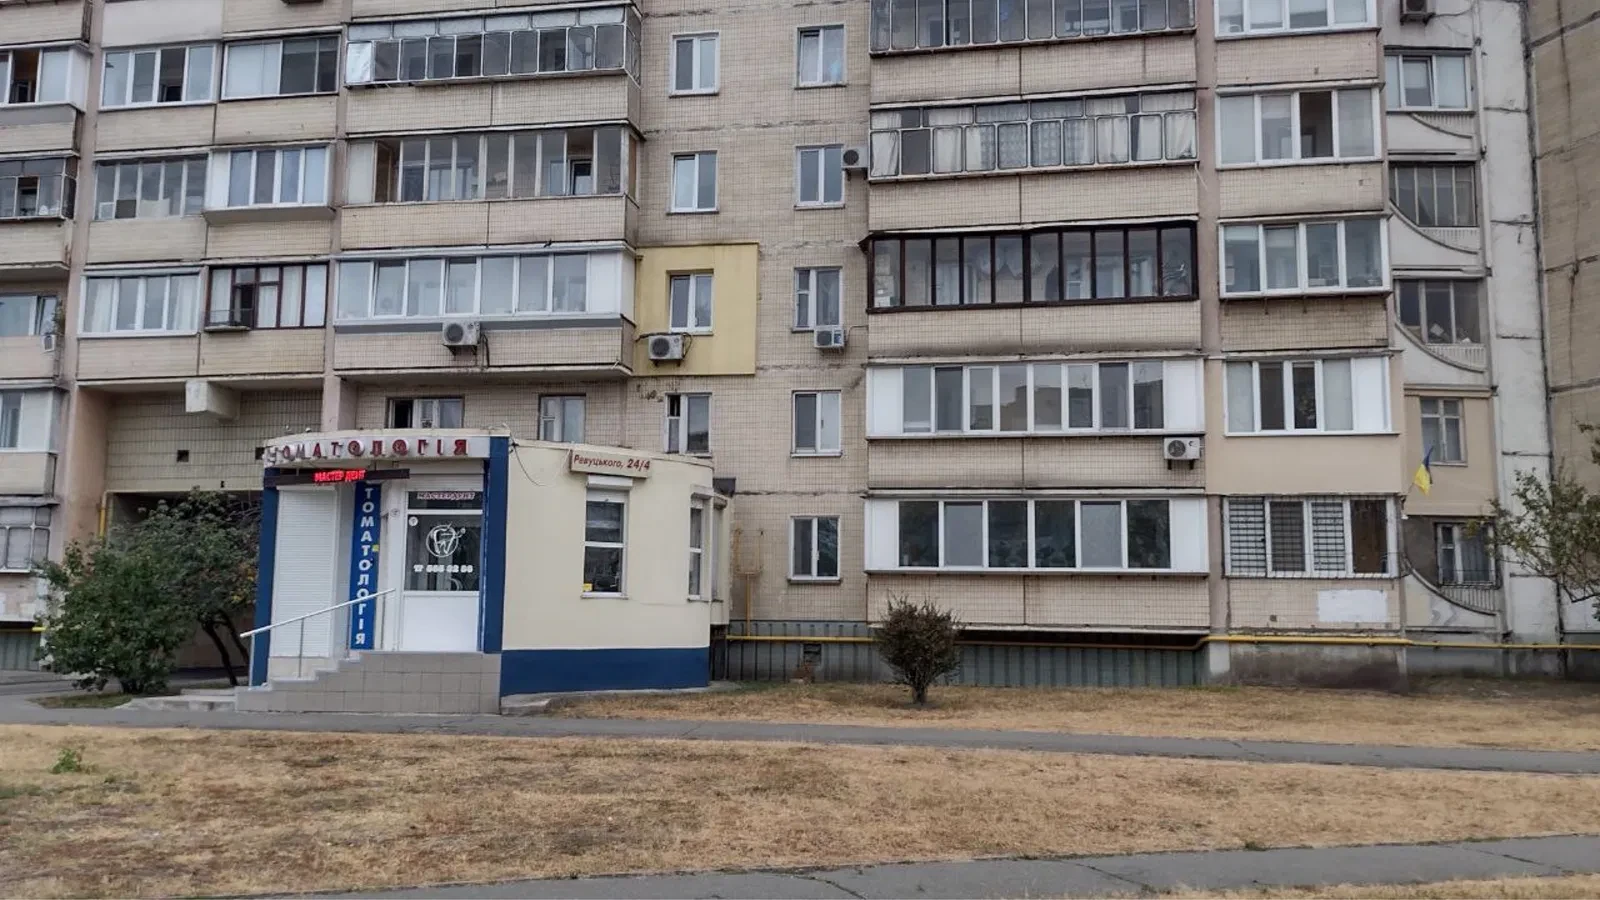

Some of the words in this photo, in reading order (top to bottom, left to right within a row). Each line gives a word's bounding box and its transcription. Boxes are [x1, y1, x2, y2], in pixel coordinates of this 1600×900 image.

[574, 454, 624, 468] Ревуцького,
[627, 458, 650, 471] 24/4
[356, 480, 375, 645] ТОМАТОЛОГІЯ
